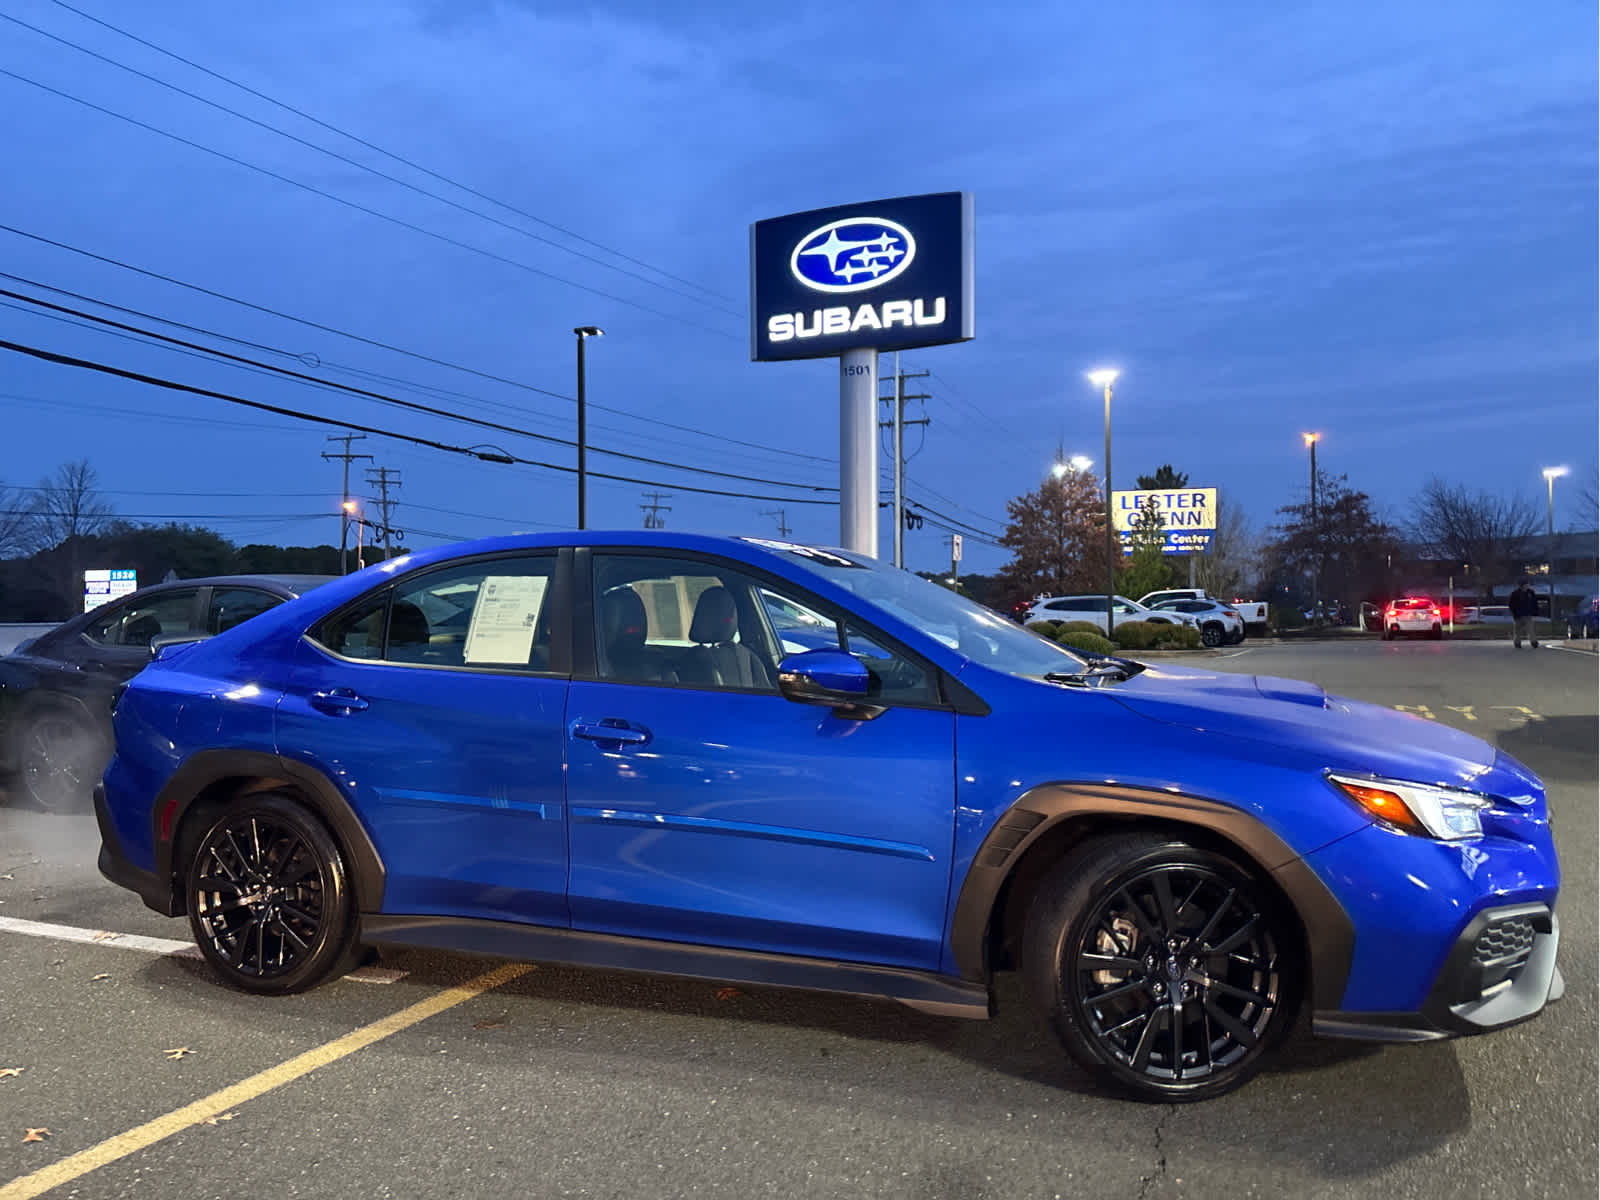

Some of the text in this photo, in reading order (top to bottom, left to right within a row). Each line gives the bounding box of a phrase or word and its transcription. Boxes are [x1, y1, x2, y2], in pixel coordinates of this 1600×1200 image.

[768, 297, 946, 342] SUBARU
[843, 365, 870, 376] 1501
[1121, 493, 1206, 509] LESTER
[1127, 511, 1202, 527] GENN
[1170, 533, 1210, 544] Center
